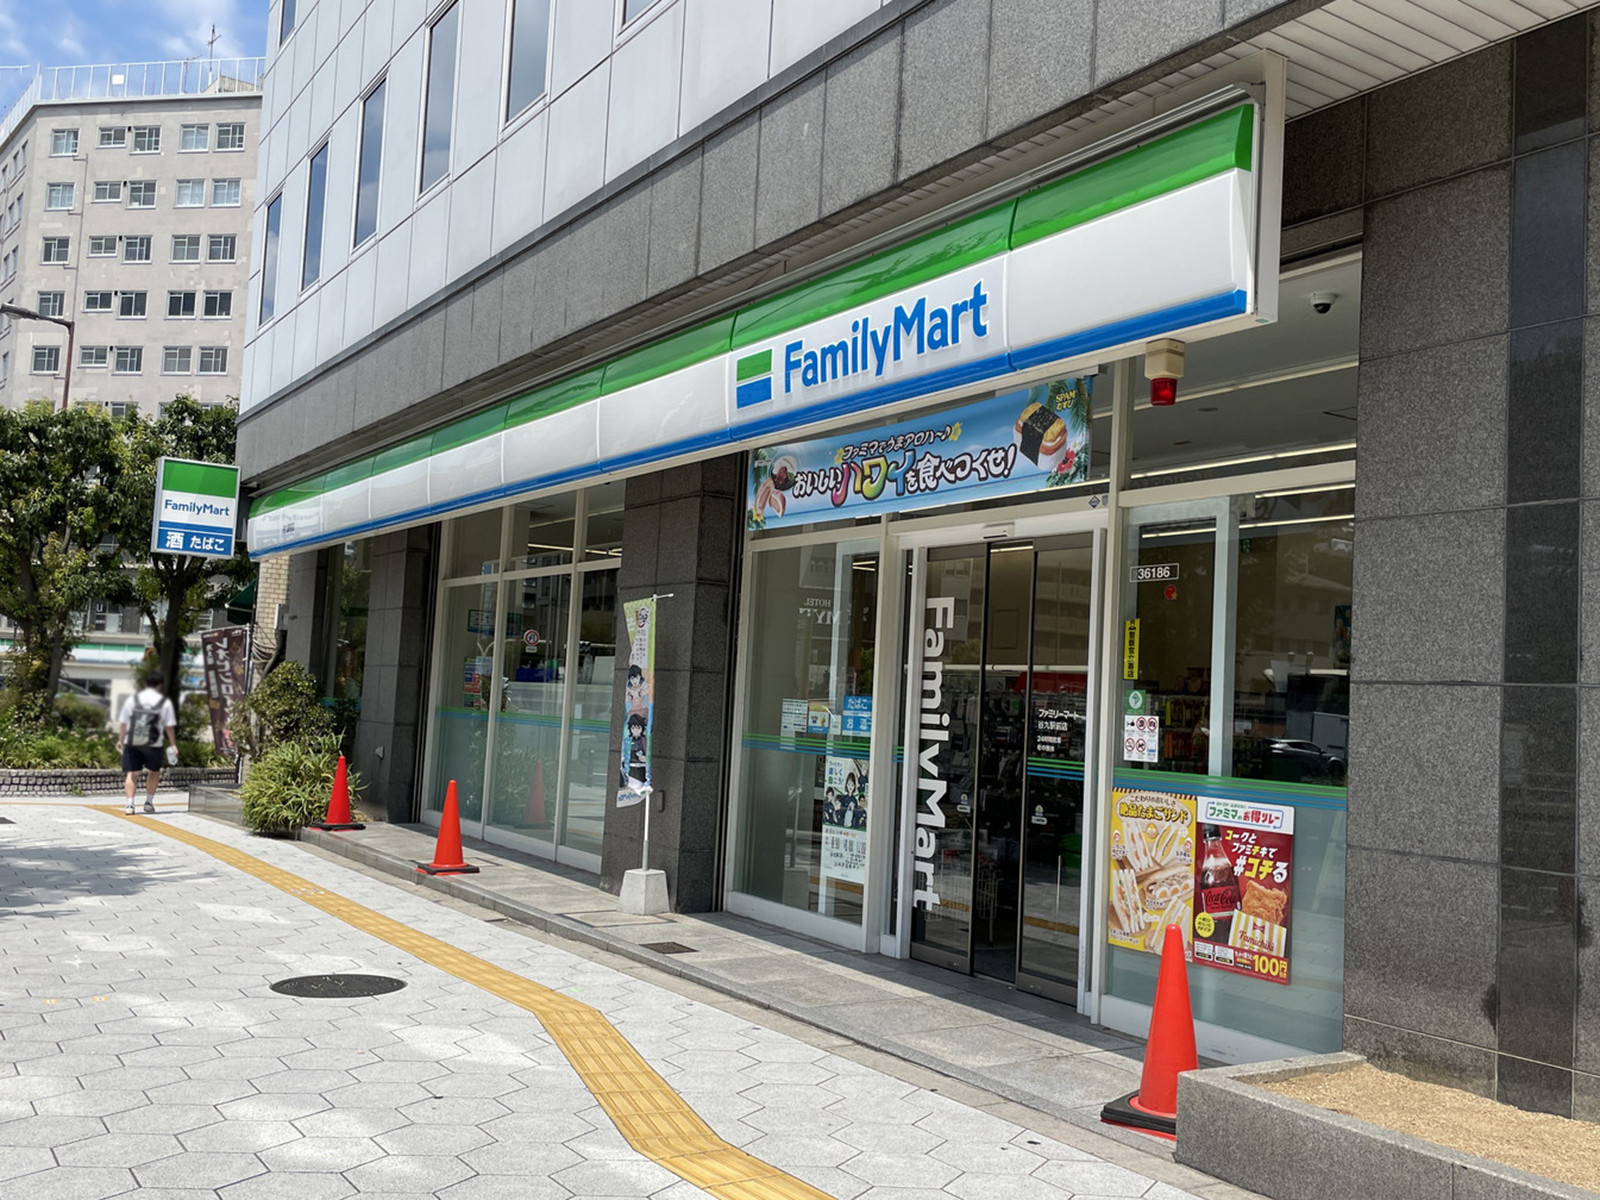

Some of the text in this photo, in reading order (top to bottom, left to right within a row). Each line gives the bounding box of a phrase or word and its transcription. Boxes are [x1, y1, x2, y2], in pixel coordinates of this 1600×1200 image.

[784, 280, 988, 394] FamilyMart
[164, 498, 230, 517] FamilyMart
[165, 532, 225, 551] 酒 たばこ
[1137, 566, 1171, 579] 36186
[1038, 709, 1080, 720] ファミリーマート
[913, 596, 955, 912] FamilyMart
[1119, 802, 1189, 824] 絶品たまごサンド
[1209, 806, 1280, 824] ファミマのお得リレー
[1225, 830, 1257, 844] コークと
[1233, 855, 1289, 884] #コチる
